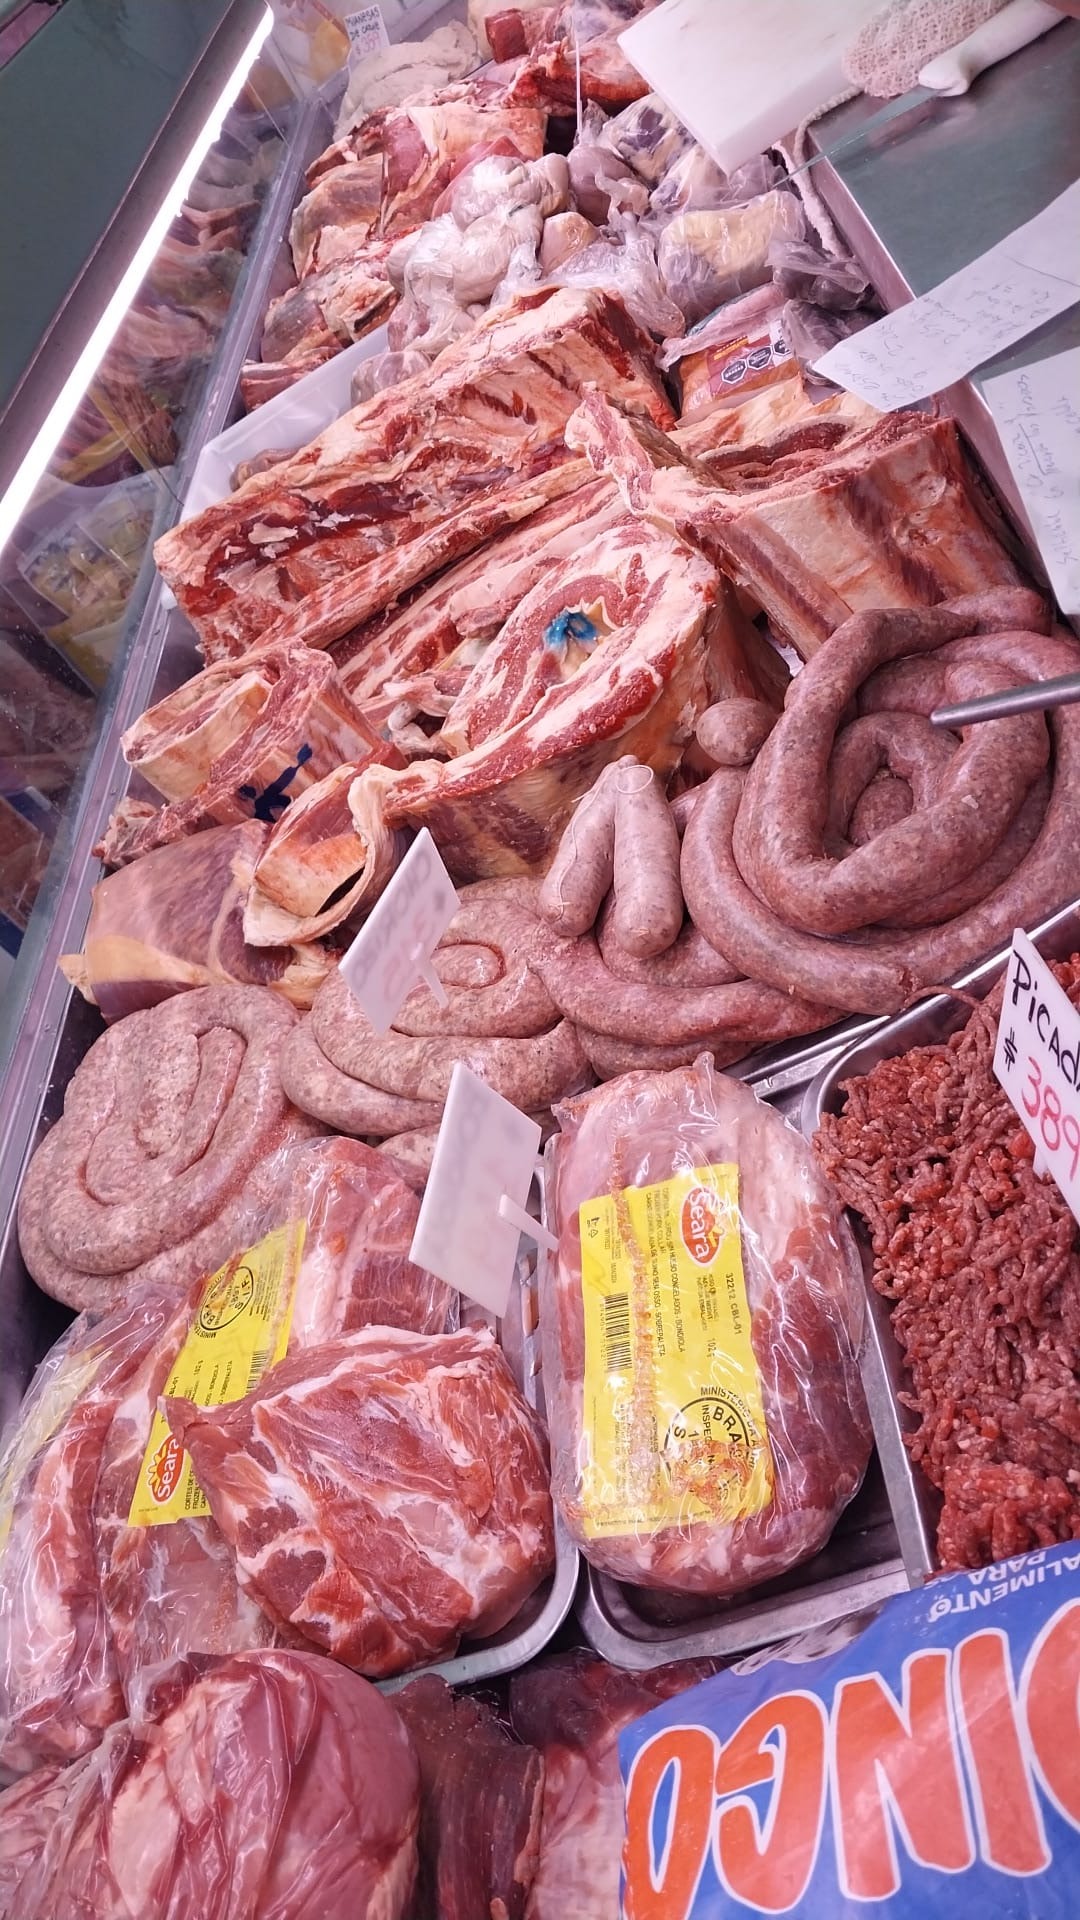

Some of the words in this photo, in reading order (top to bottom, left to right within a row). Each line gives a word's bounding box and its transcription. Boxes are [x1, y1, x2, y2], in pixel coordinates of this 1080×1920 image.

[350, 29, 361, 42] DE
[1021, 1056, 1080, 1182] 389
[686, 1187, 713, 1260] Seara
[652, 1290, 662, 1308] OSSO
[669, 1273, 683, 1315] CONGELADOS
[653, 1312, 667, 1357] SOBREPALETA
[675, 1318, 687, 1353] BONDIOLA
[219, 1361, 233, 1395] SOBREPALETA
[156, 1437, 184, 1499] Seara
[185, 1487, 193, 1510] CORTES
[928, 1551, 1080, 1623] ALIMENTO
[967, 1552, 1047, 1586] PARA
